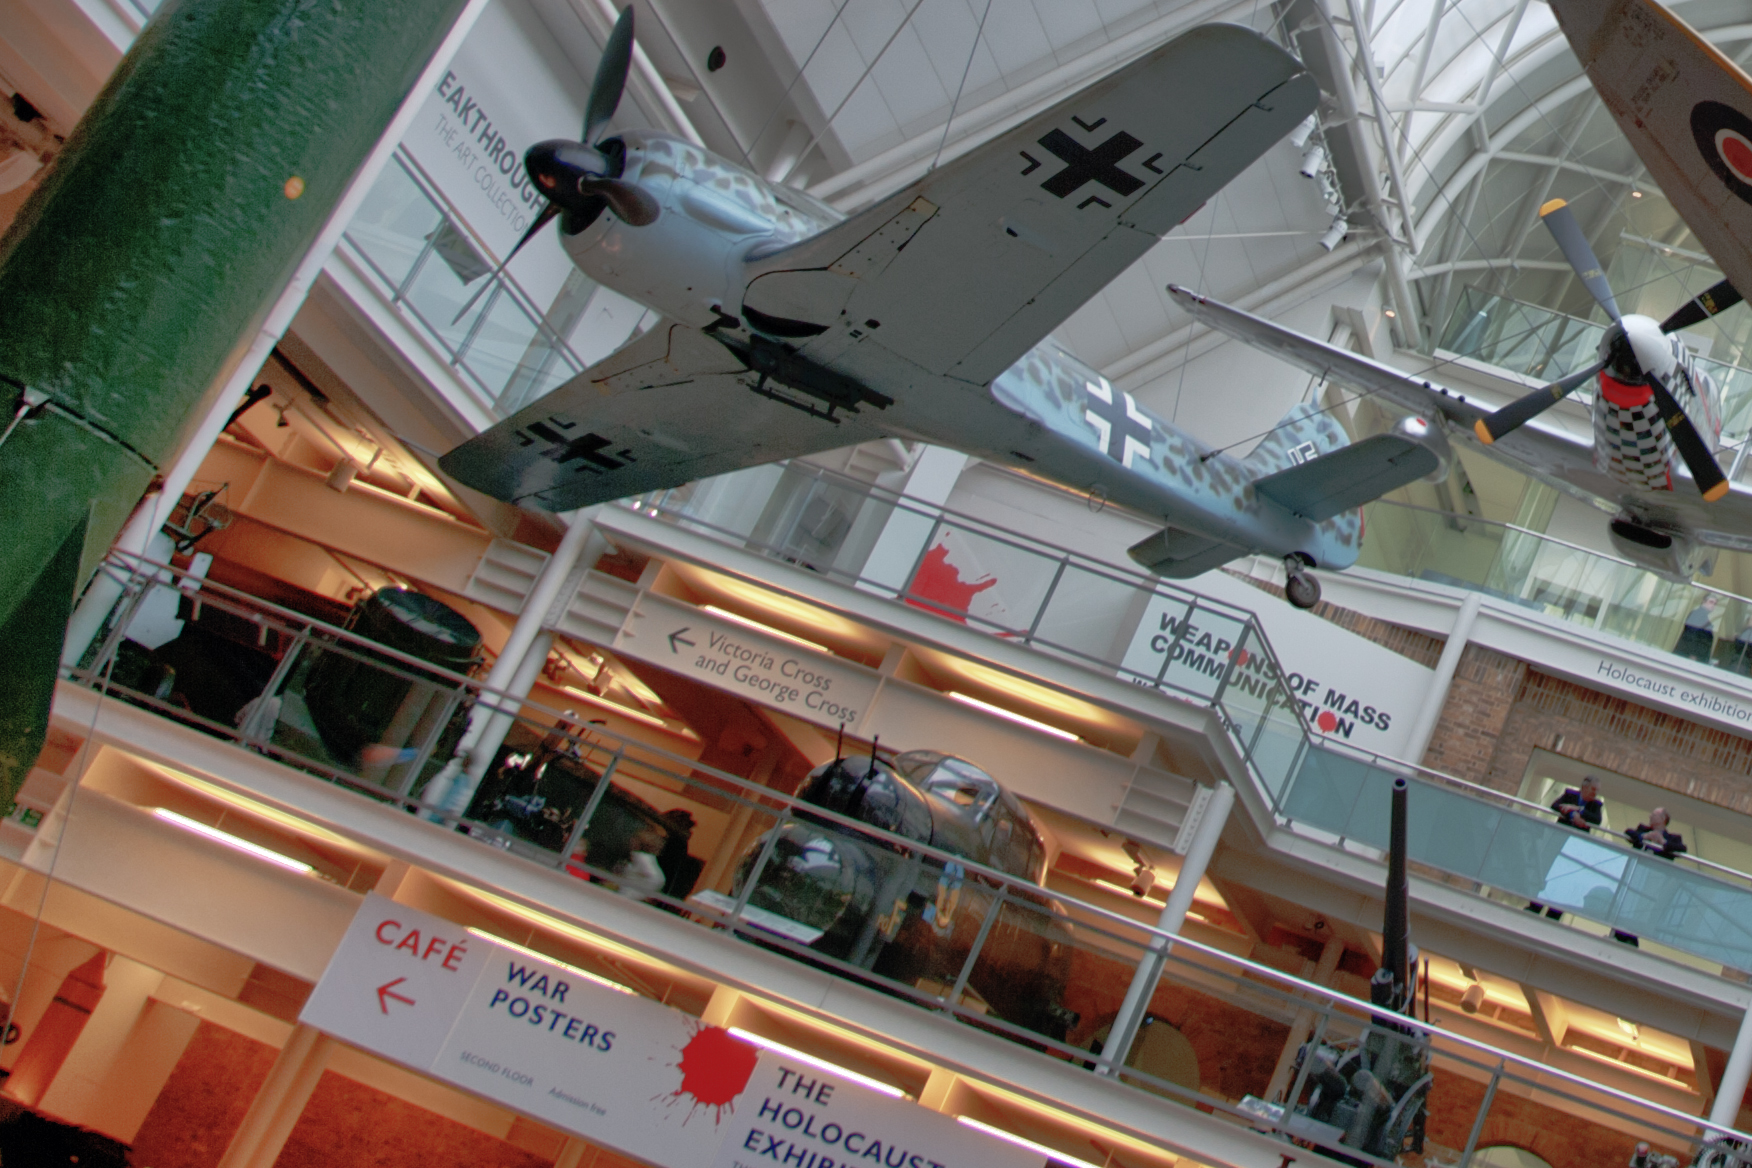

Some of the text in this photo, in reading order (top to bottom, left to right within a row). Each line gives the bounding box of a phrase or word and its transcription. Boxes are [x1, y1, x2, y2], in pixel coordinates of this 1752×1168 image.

[434, 114, 459, 148] THE
[453, 140, 479, 170] ART
[436, 70, 548, 216] EAKTHROUGH
[695, 654, 857, 723] and George Cross
[709, 631, 833, 691] Victoria Cross
[1597, 659, 1676, 698] Holocaust
[1287, 672, 1320, 696] OF
[1323, 688, 1392, 731] MASS
[375, 919, 468, 972] CAFÉ
[507, 961, 570, 1003] WAR
[489, 988, 617, 1053] POSTERS
[460, 1050, 607, 1116] SECOND FLOOR Admission free
[777, 1066, 835, 1106] THE
